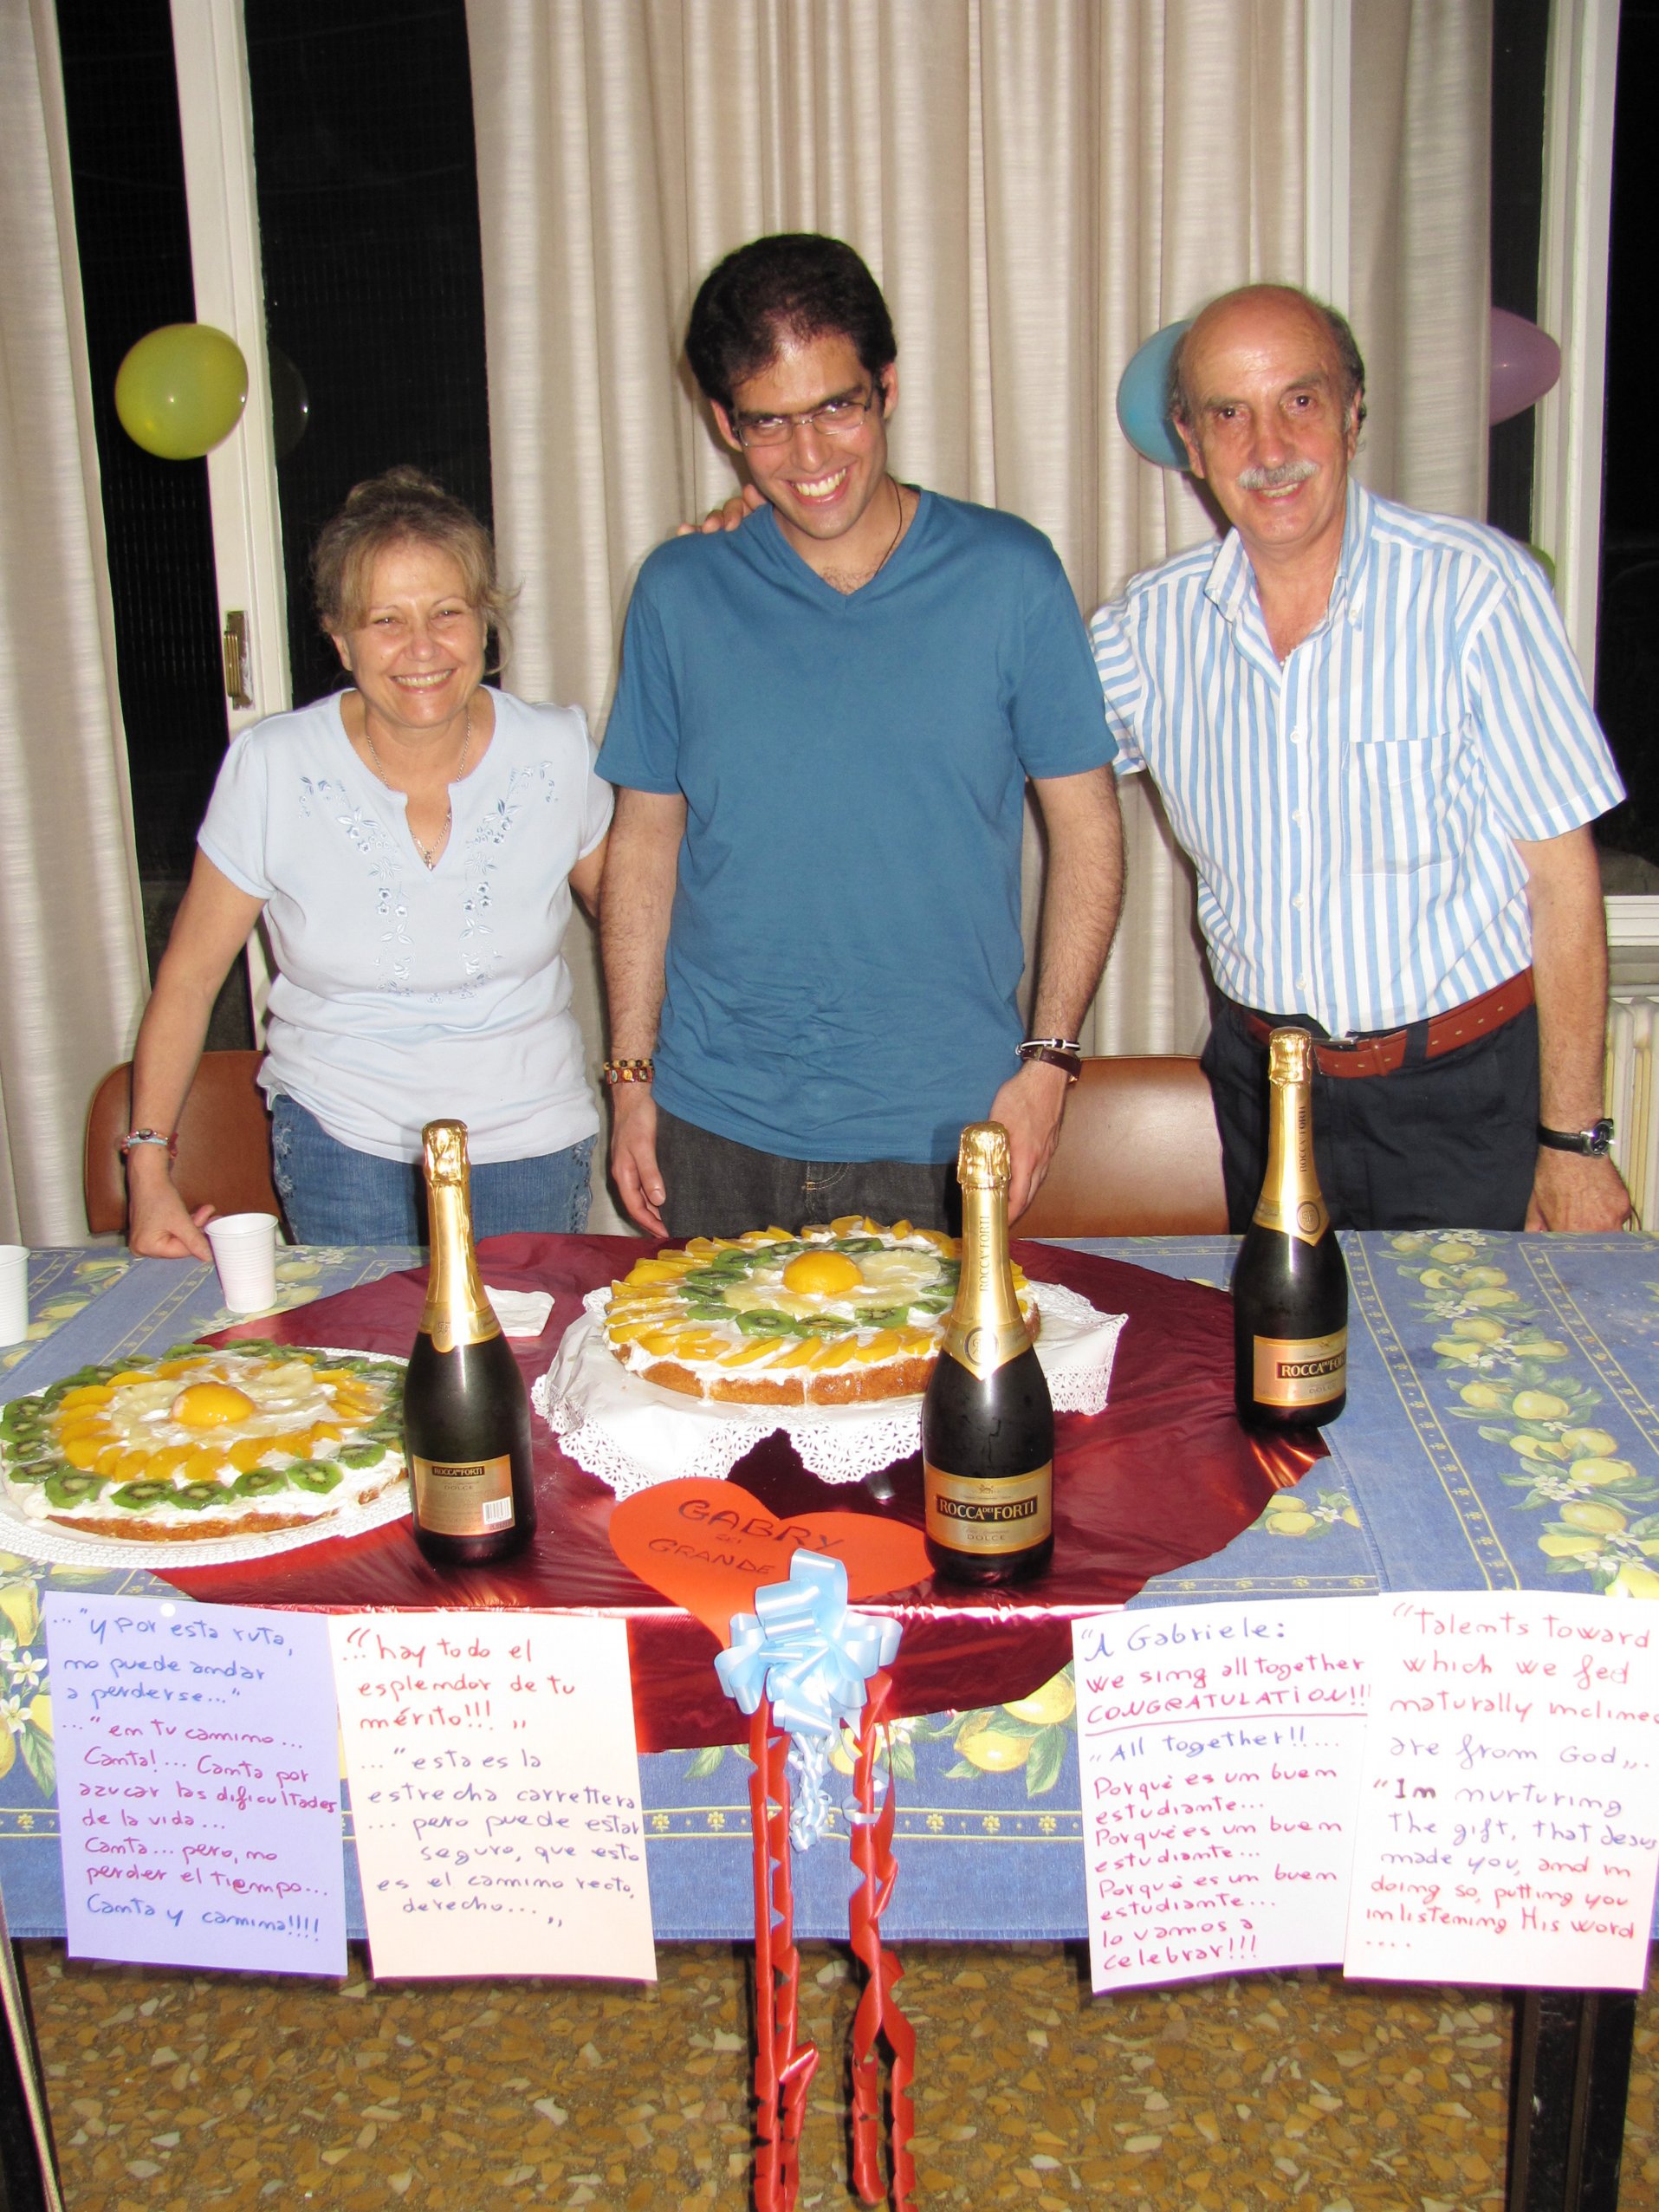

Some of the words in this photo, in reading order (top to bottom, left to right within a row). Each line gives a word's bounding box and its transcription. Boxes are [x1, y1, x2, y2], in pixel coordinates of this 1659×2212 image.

[979, 1216, 990, 1248] FORTI
[979, 1255, 990, 1292] ROCCA
[1281, 1363, 1324, 1377] ROCCA
[434, 1467, 457, 1476] ROCCA
[461, 1467, 483, 1476] FORTI
[939, 1498, 984, 1521] ROCCA
[994, 1500, 1034, 1521] FORTI
[678, 1499, 845, 1552] GABRY
[648, 1538, 777, 1576] GRANDE
[170, 1619, 218, 1639] esta
[233, 1627, 293, 1657] ruta,
[1127, 1617, 1285, 1651] Gabriele:
[509, 1638, 531, 1663] el
[1403, 1650, 1492, 1674] which
[1516, 1660, 1556, 1677] we
[109, 1654, 181, 1678] puede
[191, 1660, 265, 1680] andar
[1139, 1667, 1207, 1690] sing
[1222, 1657, 1247, 1677] all
[1254, 1653, 1364, 1682] together
[67, 1688, 78, 1700] a
[358, 1673, 491, 1703] esplendor
[510, 1676, 537, 1692] de
[547, 1675, 575, 1695] tu
[1390, 1690, 1533, 1722] naturally
[150, 1719, 177, 1736] tu
[483, 1756, 509, 1768] es
[522, 1748, 541, 1768] la
[1390, 1737, 1439, 1756] are
[1461, 1734, 1538, 1769] from
[197, 1755, 263, 1779] Canta
[275, 1769, 309, 1789] por
[1184, 1774, 1215, 1786] es
[79, 1783, 159, 1799] azucar
[175, 1781, 207, 1800] las
[216, 1786, 338, 1813] dificultades
[368, 1782, 497, 1803] estrecha
[1455, 1783, 1622, 1818] nurturing
[81, 1812, 108, 1826] de
[120, 1809, 139, 1826] la
[148, 1813, 225, 1829] vida...
[412, 1816, 469, 1841] pero
[485, 1810, 570, 1837] puede
[585, 1814, 639, 1835] estar
[1183, 1826, 1211, 1838] es
[1453, 1818, 1516, 1846] gift,
[1532, 1820, 1592, 1843] that
[182, 1844, 238, 1866] pero,
[420, 1845, 521, 1866] seguro,
[535, 1846, 576, 1865] que
[1381, 1847, 1452, 1865] made
[1468, 1857, 1520, 1877] you,
[1539, 1856, 1591, 1873] and
[86, 1864, 167, 1885] perder
[180, 1867, 202, 1884] el
[377, 1879, 409, 1891] es
[429, 1871, 450, 1888] el
[468, 1875, 564, 1889] camino
[575, 1877, 634, 1899] recto,
[1193, 1876, 1219, 1886] es
[1371, 1874, 1441, 1905] doing
[1455, 1884, 1481, 1904] so,
[1494, 1883, 1572, 1911] putting
[1584, 1893, 1629, 1910] you
[87, 1893, 156, 1916] Canta
[166, 1910, 184, 1927] y
[1400, 1902, 1507, 1934] listening
[1521, 1906, 1560, 1933] His
[1571, 1920, 1636, 1939] word
[1103, 1930, 1123, 1949] lo
[1133, 1921, 1227, 1941] vamos
[1240, 1918, 1254, 1931] a
